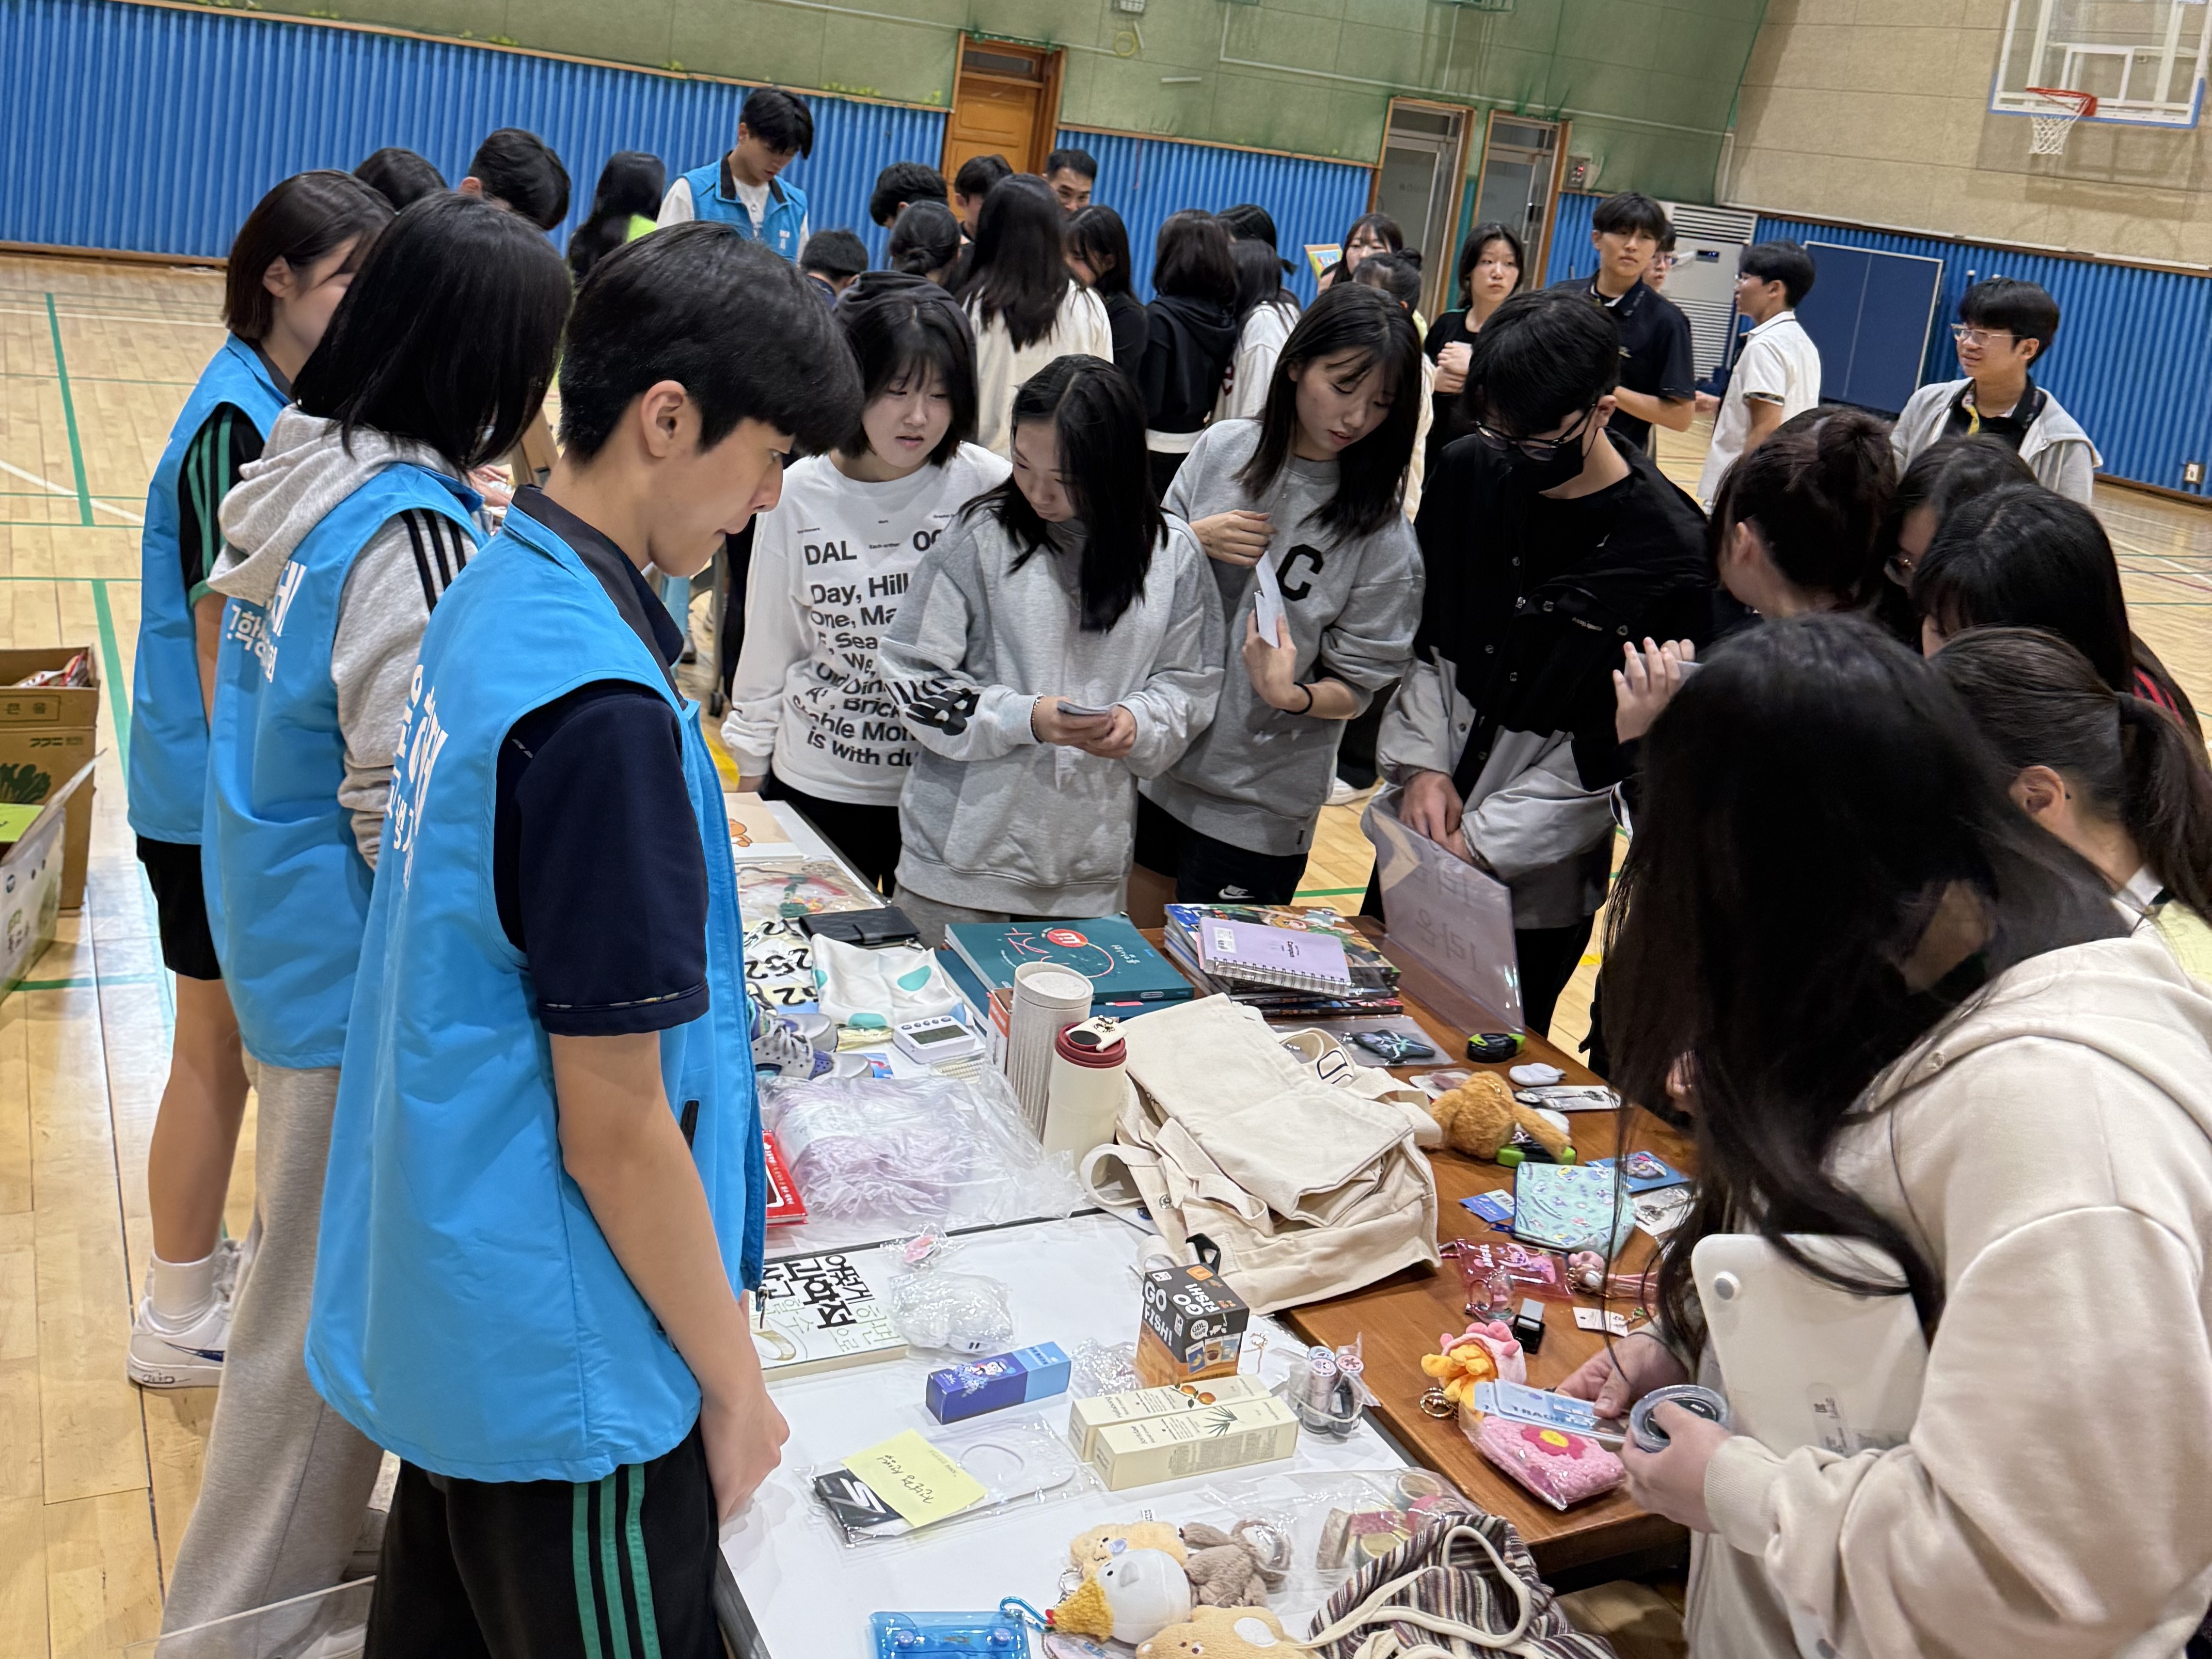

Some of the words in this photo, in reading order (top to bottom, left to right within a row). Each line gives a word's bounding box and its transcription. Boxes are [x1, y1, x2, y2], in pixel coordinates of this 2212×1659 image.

[804, 540, 857, 565] DAL
[1276, 544, 1324, 602] C
[811, 584, 861, 606] Day,
[811, 610, 856, 629] One,
[842, 653, 876, 677] We,
[807, 726, 826, 749] is
[832, 740, 880, 765] with
[783, 1258, 860, 1352] 과학적으로
[825, 1255, 875, 1304] 어떻게
[856, 1305, 900, 1345] 하면
[1145, 1281, 1167, 1312] GO
[1173, 1294, 1204, 1315] GO
[1185, 1283, 1220, 1313] FISH!
[1145, 1303, 1172, 1347] FISH!
